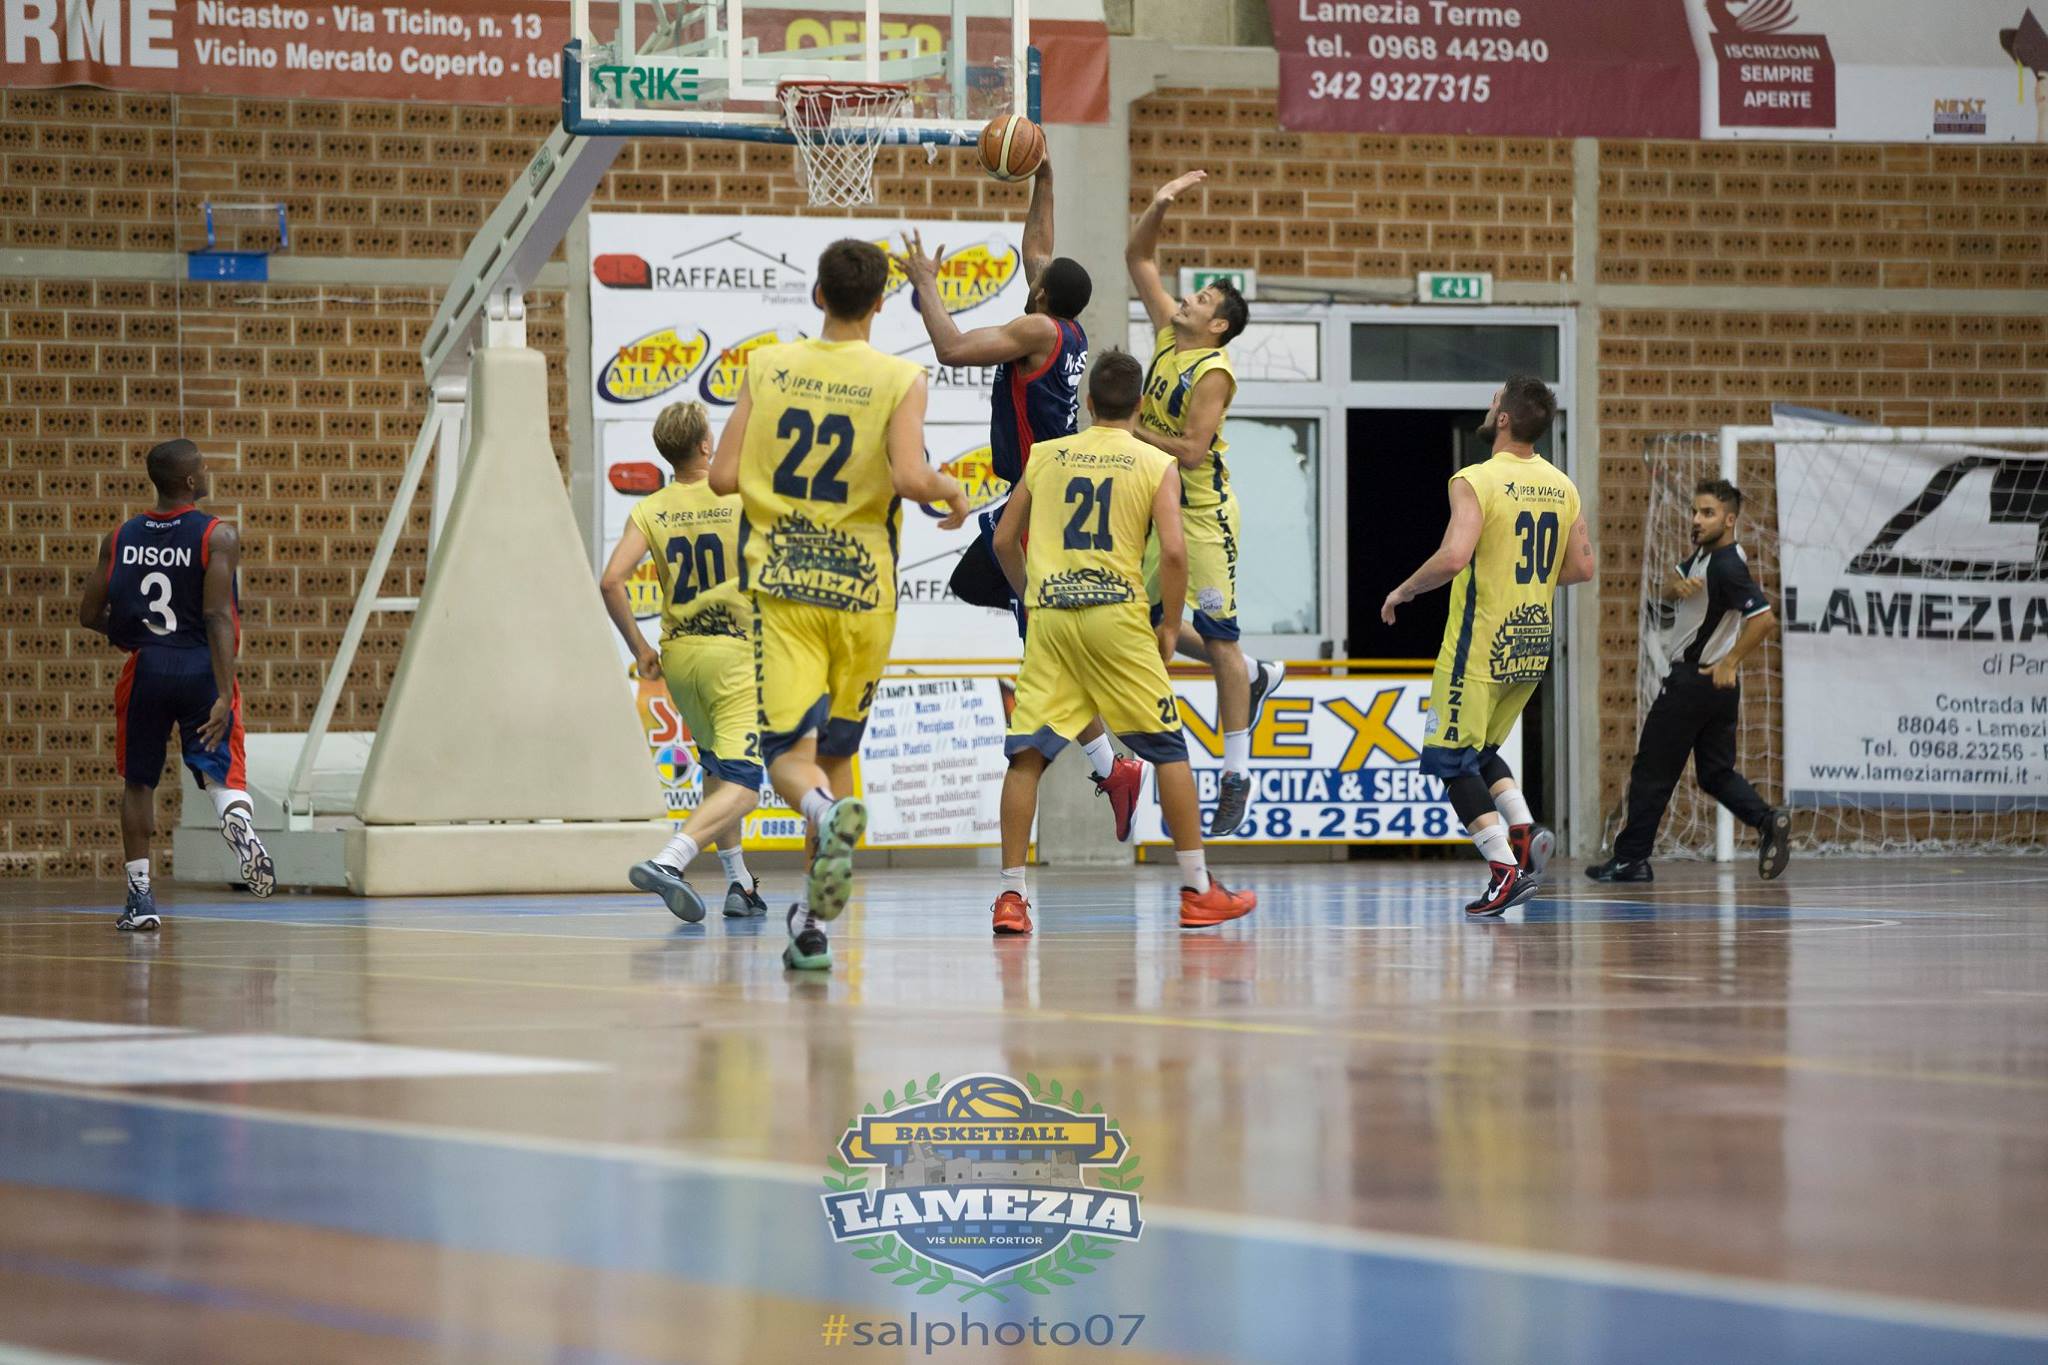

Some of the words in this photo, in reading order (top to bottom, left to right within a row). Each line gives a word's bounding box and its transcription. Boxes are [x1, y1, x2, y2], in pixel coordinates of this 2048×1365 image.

[197, 1, 309, 30] Nicastro
[333, 6, 375, 33] Via
[382, 8, 471, 41] Ticino,
[479, 17, 502, 38] n.
[511, 13, 543, 39] 13
[1300, 0, 1420, 25] Lamezia
[1430, 0, 1522, 27] Terme
[195, 38, 278, 69] Vicino
[286, 43, 393, 73] Mercato
[400, 46, 504, 80] Coperto
[1307, 34, 1351, 58] tel.
[1368, 34, 1438, 60] 0968
[1446, 37, 1549, 63] 442940
[1724, 44, 1820, 60] ISCRIZIONI
[594, 65, 699, 101] STRIKE
[1309, 71, 1361, 100] 342
[1369, 72, 1491, 103] 9327315
[1740, 65, 1814, 83] SEMPRE
[1743, 90, 1812, 109] APERTE
[656, 267, 777, 289] RAFFAELE
[618, 344, 698, 368] NEXT
[791, 375, 824, 393] IPER
[827, 382, 873, 399] VIAGGI
[773, 407, 855, 504] 22
[1063, 476, 1114, 552] 21
[122, 545, 192, 568] DISON
[1514, 510, 1559, 585] 30
[665, 532, 726, 605] 20
[140, 572, 178, 636] 3
[1982, 653, 2002, 676] di
[1157, 697, 1178, 724] 21
[1936, 693, 2024, 714] Contrada
[1174, 685, 1431, 774] NEX
[1897, 716, 1959, 736] 88046
[1861, 738, 1897, 757] Tel.
[1910, 740, 2024, 760] 0968.23256
[1338, 774, 1364, 802] &
[1373, 773, 1446, 802] SERV
